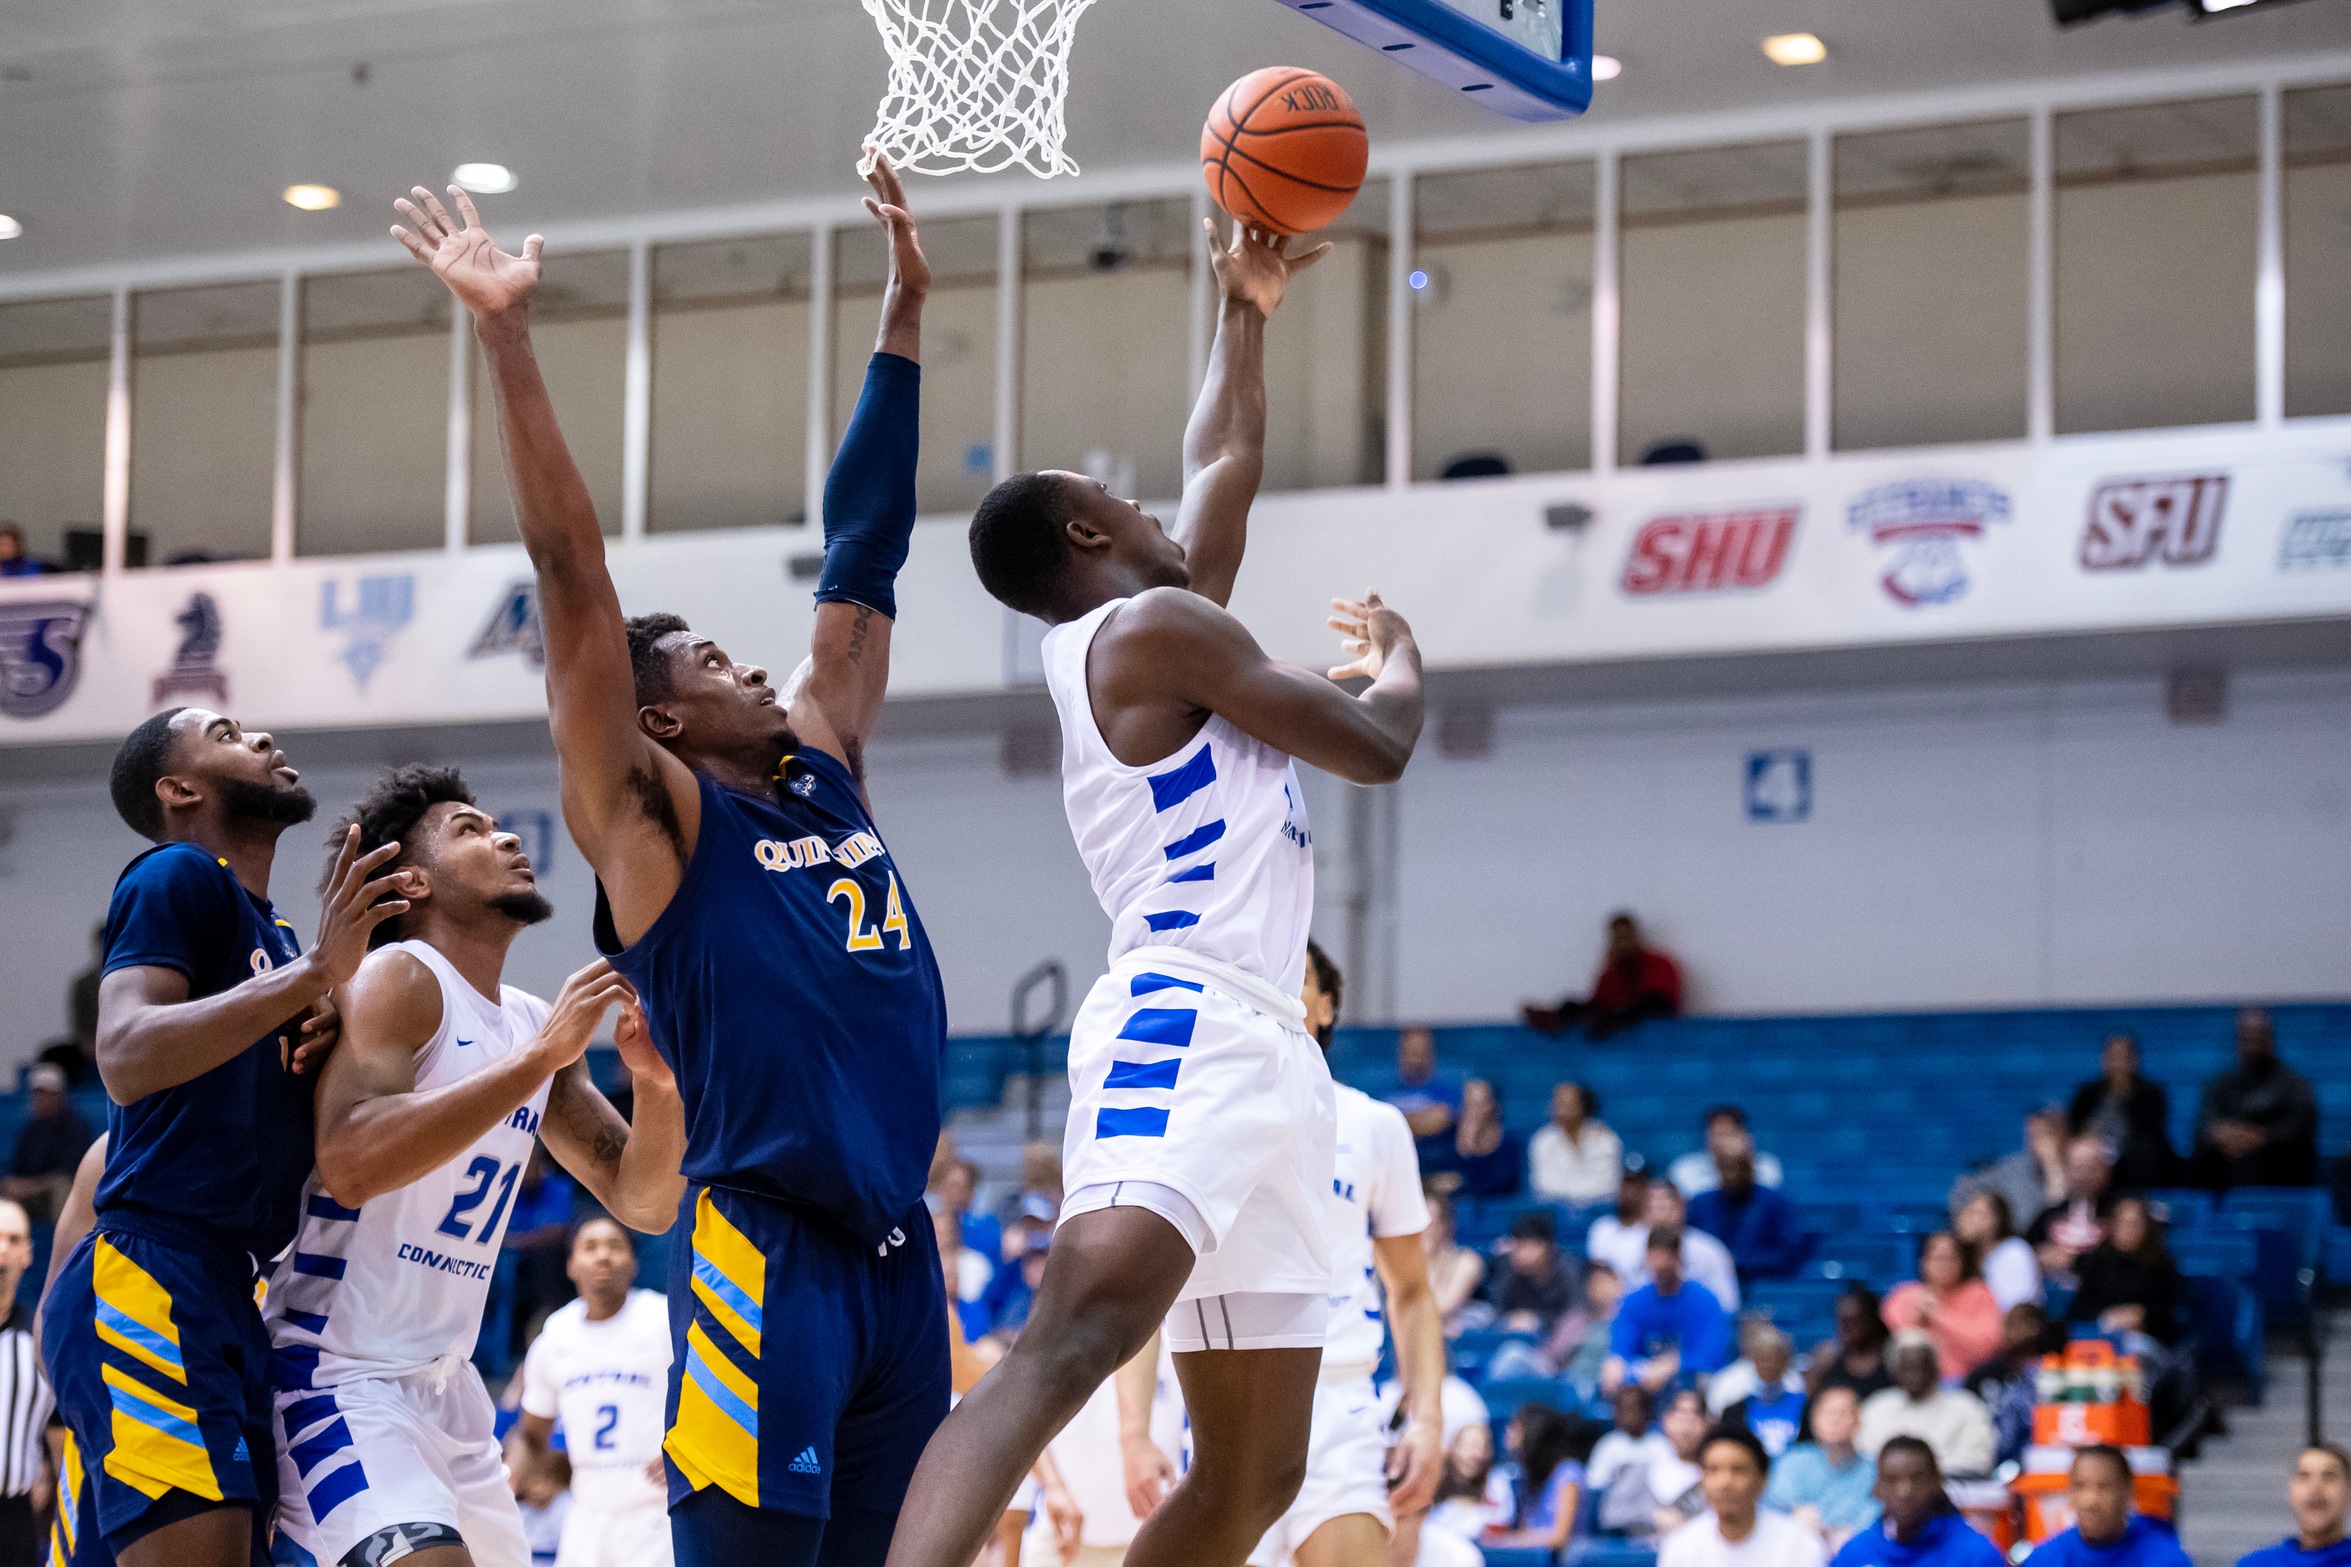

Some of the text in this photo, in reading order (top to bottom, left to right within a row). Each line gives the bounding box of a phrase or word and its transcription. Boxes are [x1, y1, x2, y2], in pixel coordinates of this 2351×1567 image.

[1281, 84, 1339, 112] ROCK
[1622, 504, 1803, 597] SHU
[2078, 473, 2231, 573] SFU
[1754, 755, 1800, 819] 4
[826, 870, 912, 953] 24
[435, 1152, 523, 1248] 21
[593, 1403, 619, 1451] 2
[788, 1461, 821, 1475] adidas
